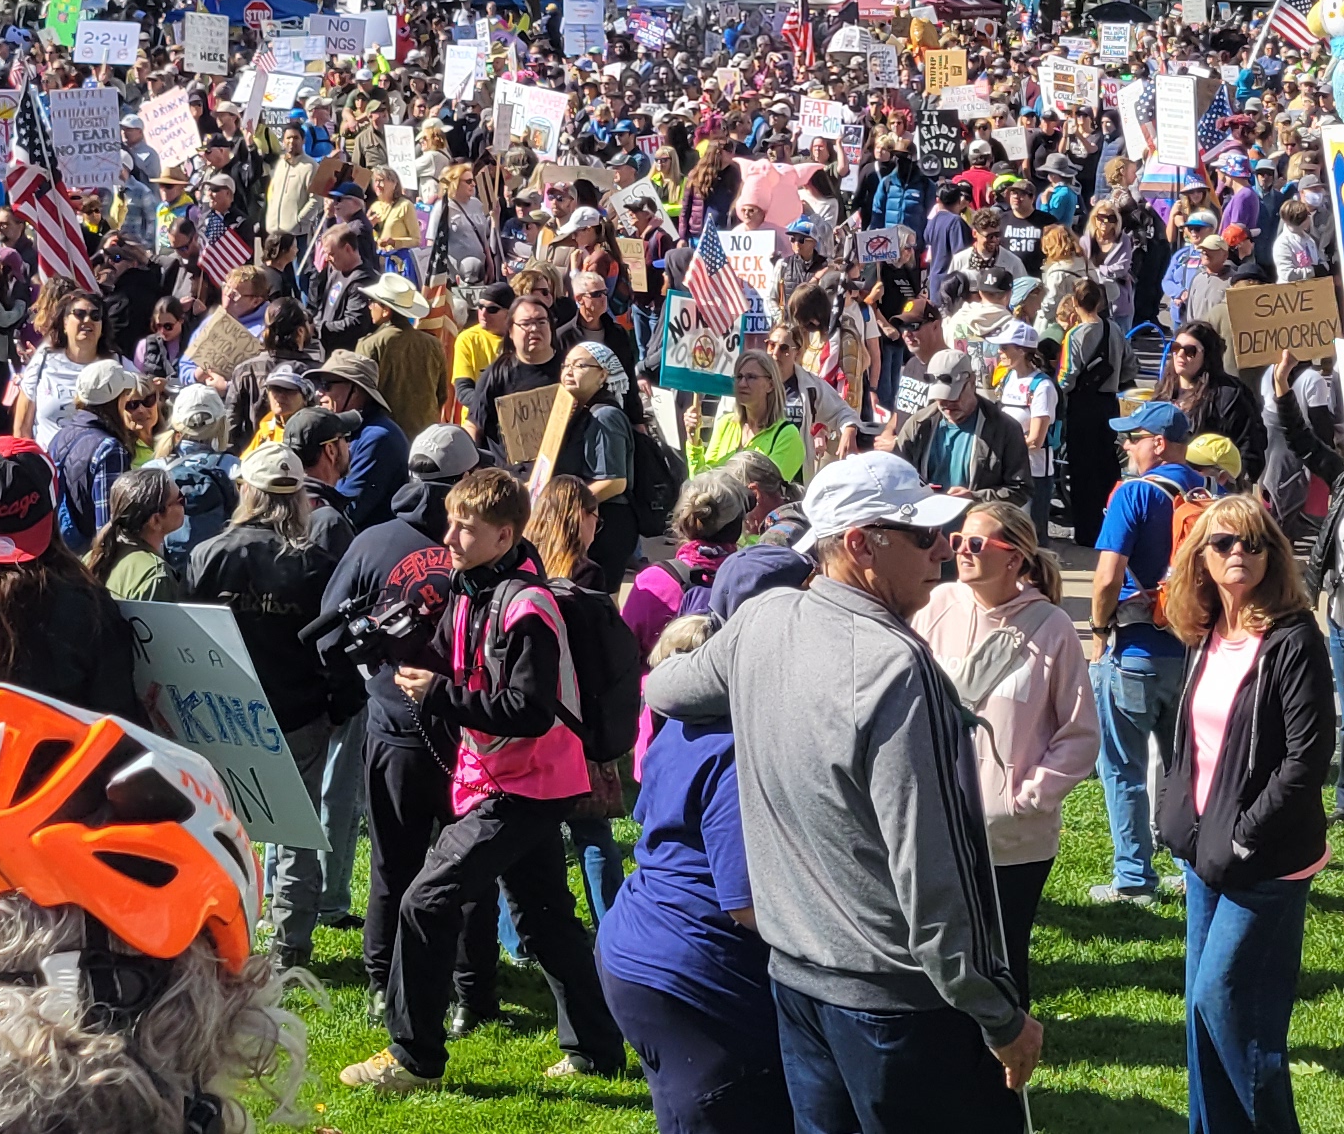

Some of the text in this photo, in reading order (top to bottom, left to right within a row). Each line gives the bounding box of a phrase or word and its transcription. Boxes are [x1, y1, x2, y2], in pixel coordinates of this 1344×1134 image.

[245, 10, 271, 23] STOP
[328, 19, 350, 32] NO
[199, 51, 227, 63] HERE
[153, 102, 178, 118] DRINK
[803, 100, 832, 115] EAT
[800, 114, 822, 128] THE
[921, 111, 939, 125] IT
[73, 128, 114, 141] FEAR!
[921, 123, 957, 139] ENDS
[56, 142, 122, 156] NO KINGS
[921, 136, 955, 154] WITH
[943, 157, 958, 169] US
[1005, 224, 1041, 239] Austin
[730, 235, 752, 251] NO
[1009, 238, 1035, 252] 3:16
[862, 250, 897, 263] NO KINGS
[1254, 290, 1314, 317] SAVE
[668, 307, 691, 345] NO
[1239, 318, 1338, 355] DEMOCRACY
[177, 647, 225, 668] IS A
[166, 683, 283, 754] KING
